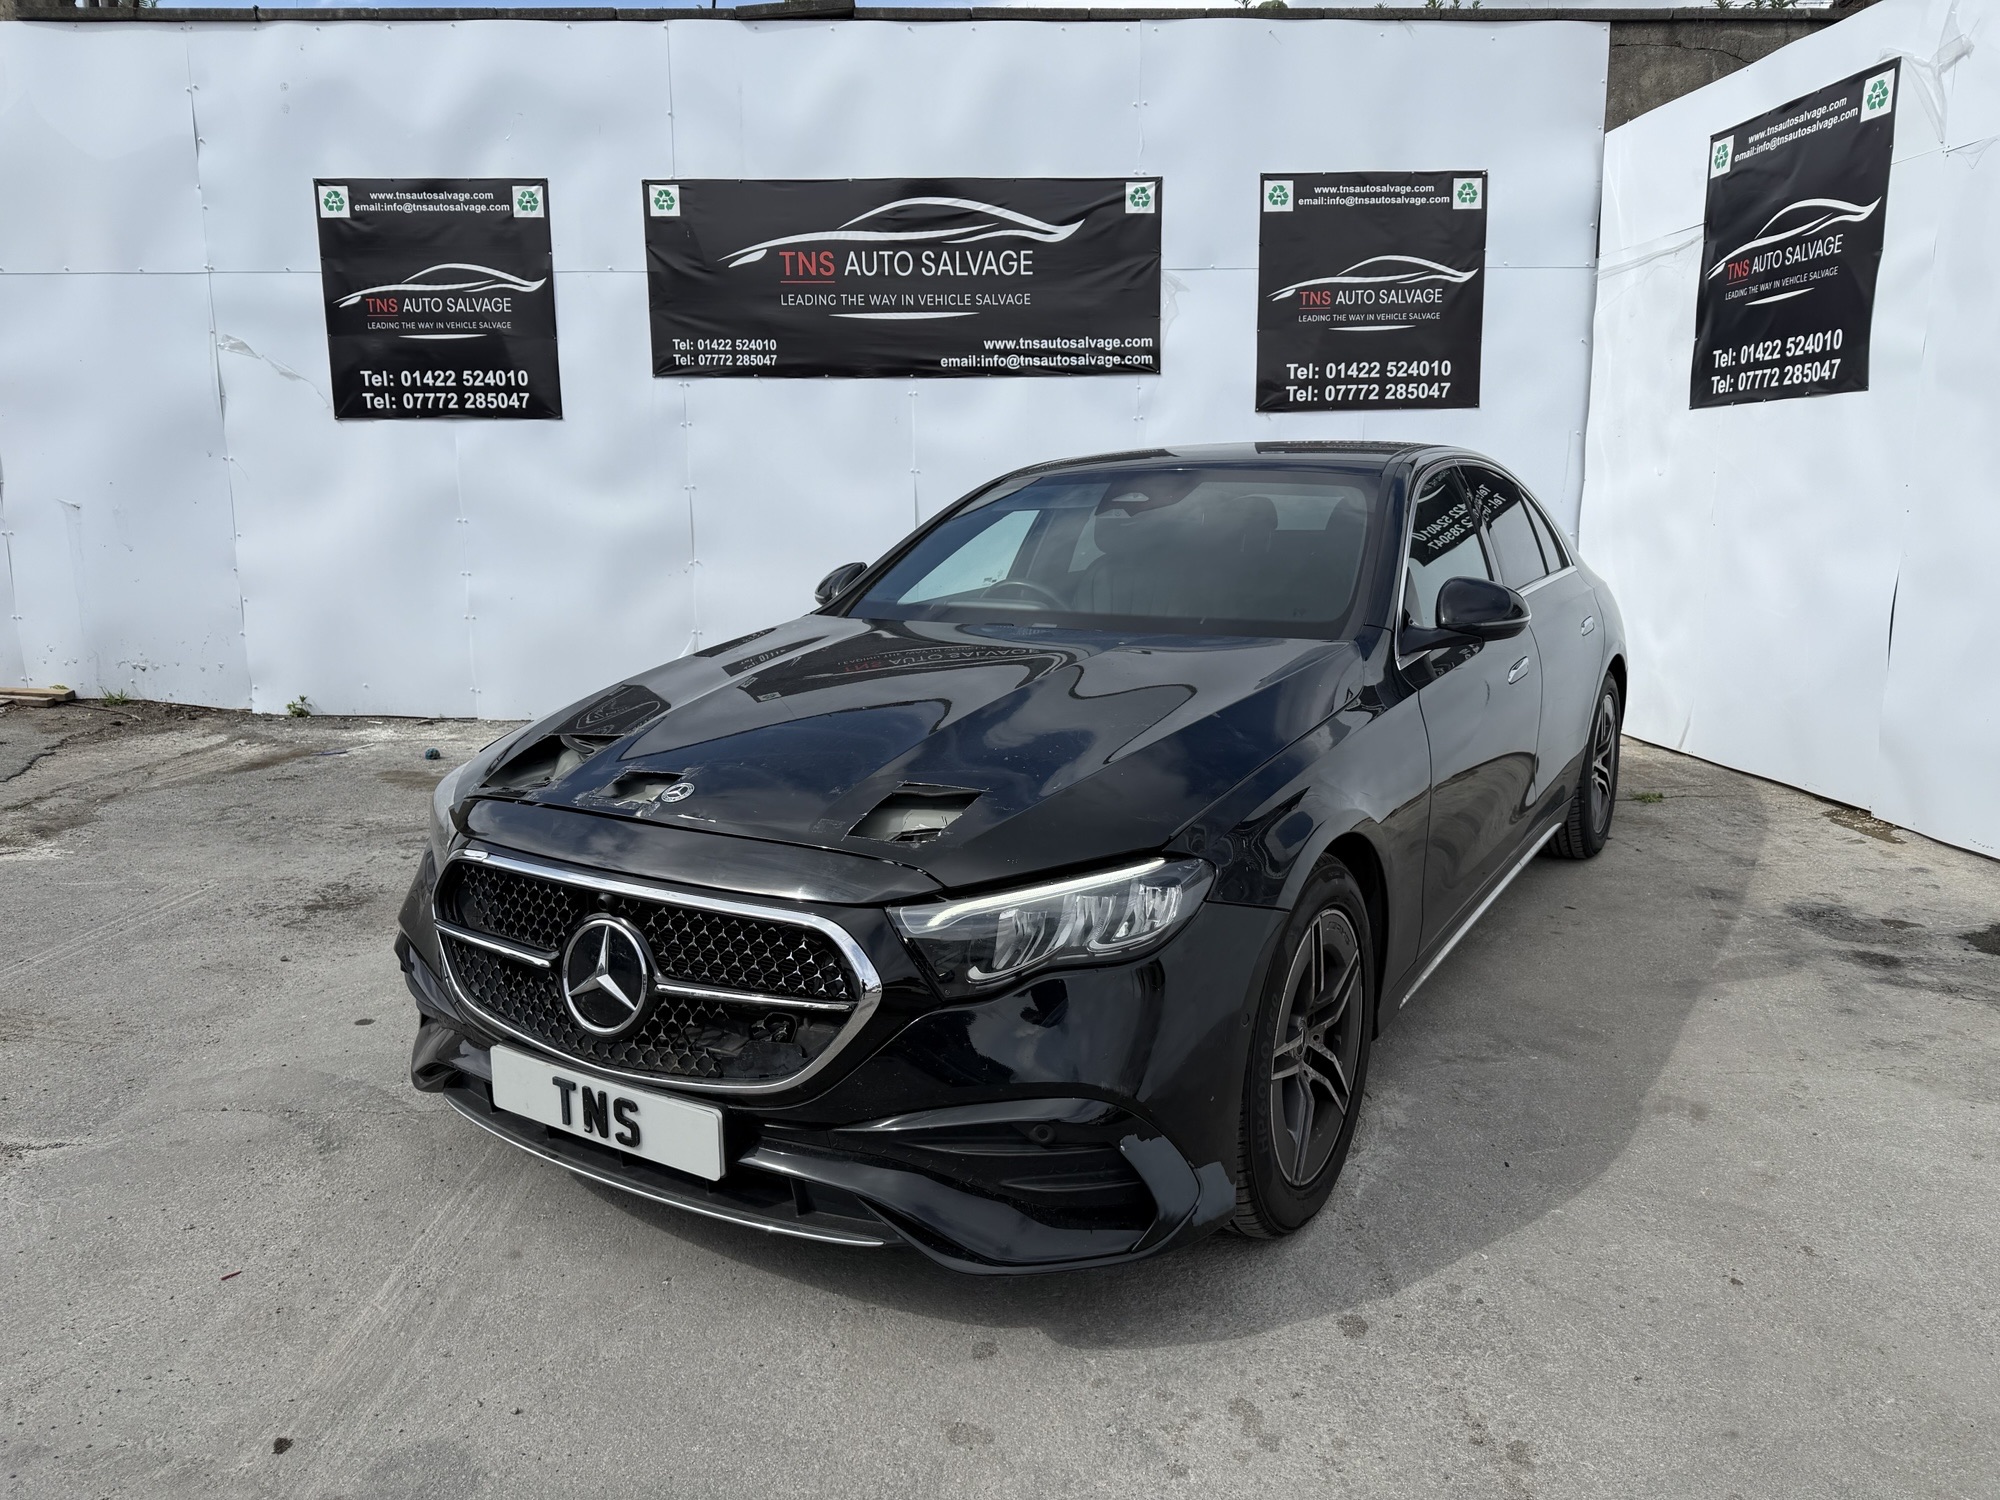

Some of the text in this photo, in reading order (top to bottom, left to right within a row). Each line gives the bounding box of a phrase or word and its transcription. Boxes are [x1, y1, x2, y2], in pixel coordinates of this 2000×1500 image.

[1748, 96, 1848, 144] www.tnsautosalvage.com
[1734, 107, 1858, 162] email:info@tnsautosalvage.com
[369, 191, 494, 201] www.tnsautosalvage.com
[1314, 184, 1435, 194] www.tnsautosalvage.com
[354, 202, 510, 213] email:info@tnsautosalvage.com
[1298, 195, 1450, 207] email:info@tnsautosalvage.com
[779, 250, 1033, 276] TNS AUTO SALVAGE
[1727, 233, 1844, 281] TNS AUTO SALVAGE
[1725, 266, 1839, 301] LEADING THE WAY IN VEHICLE SALVAGE
[366, 297, 512, 313] TNS AUTO SALVAGE
[780, 293, 1031, 306] LEADING THE WAY IN VEHICLE SALVAGE
[1299, 288, 1443, 305] TNS AUTO SALVAGE
[367, 321, 512, 330] LEADING THE WAY IN VEHICLE SALVAGE
[1298, 314, 1331, 323] LEADING
[1333, 314, 1347, 322] THE
[1366, 313, 1374, 321] IN
[1376, 313, 1407, 321] VEHICLE
[1409, 312, 1441, 320] SALVAGE
[672, 339, 777, 350] Tel: 01422 524010
[984, 336, 1153, 350] www.tnsautosalvage.com
[1712, 328, 1844, 369] Tel: 01422 524010
[673, 354, 778, 366] Tel: 07772 285047
[940, 353, 1153, 369] email:info@tnsautosalvage.com
[360, 370, 529, 387] Tel: 01422 524010
[1286, 360, 1451, 380] Tel: 01422 524010
[1711, 358, 1841, 394] Tel: 07772 285047
[362, 392, 530, 409] Tel: 07772 285047
[1285, 382, 1451, 402] Tel: 07772 285047
[552, 1076, 641, 1148] TNS
